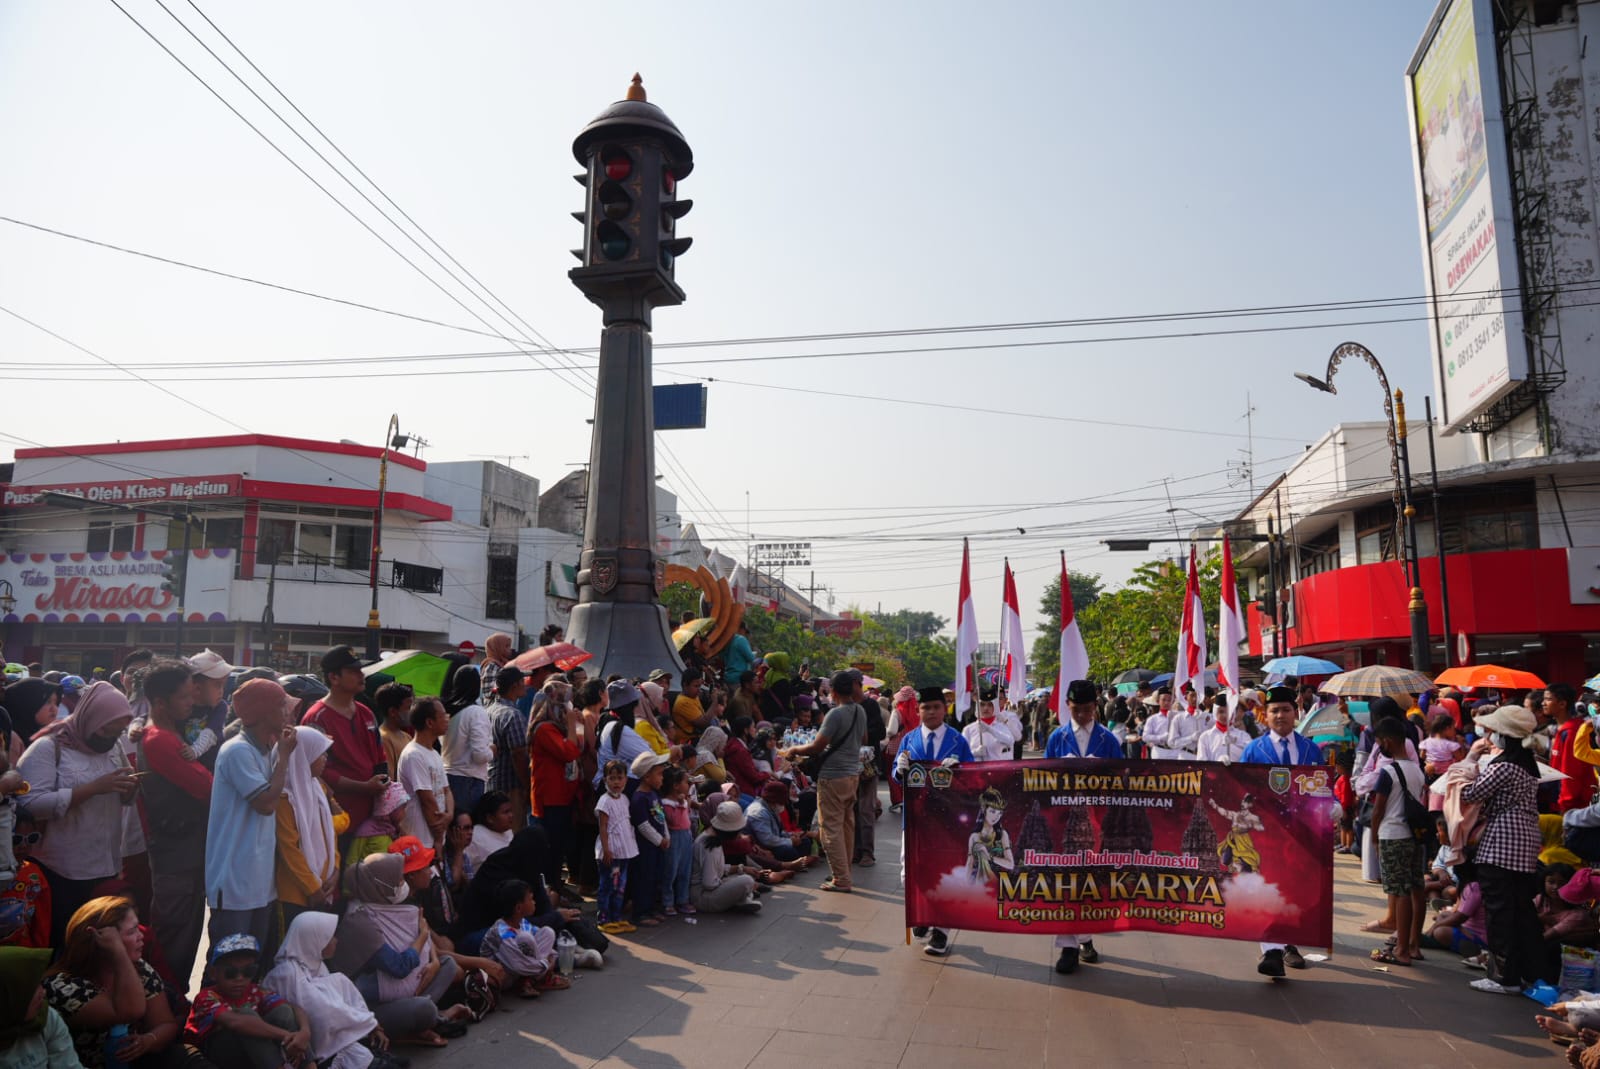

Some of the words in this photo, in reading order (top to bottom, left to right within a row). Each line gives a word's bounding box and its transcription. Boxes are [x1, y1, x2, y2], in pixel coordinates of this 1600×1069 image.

[1447, 219, 1494, 289] DISEWAKAN
[88, 485, 123, 501] Oleh
[126, 485, 166, 499] Khas
[169, 481, 229, 497] Madiun
[88, 564, 114, 576] ASLI
[35, 577, 172, 610] Mirasa
[1022, 768, 1058, 791] MIN
[1062, 773, 1071, 790] 1
[1074, 774, 1124, 790] KOTA
[1128, 770, 1203, 795] MADIUN
[1051, 796, 1173, 807] MEMPERSEMBAHKAN
[1024, 849, 1082, 867] Harmoni
[1084, 850, 1131, 869] Budaya
[1133, 851, 1199, 869] Indonesia
[998, 871, 1101, 902] MAHA
[1109, 871, 1225, 905] KARYA
[997, 903, 1075, 925] Legenda
[1080, 904, 1121, 920] Roro
[1124, 903, 1225, 929] Jonggrang
